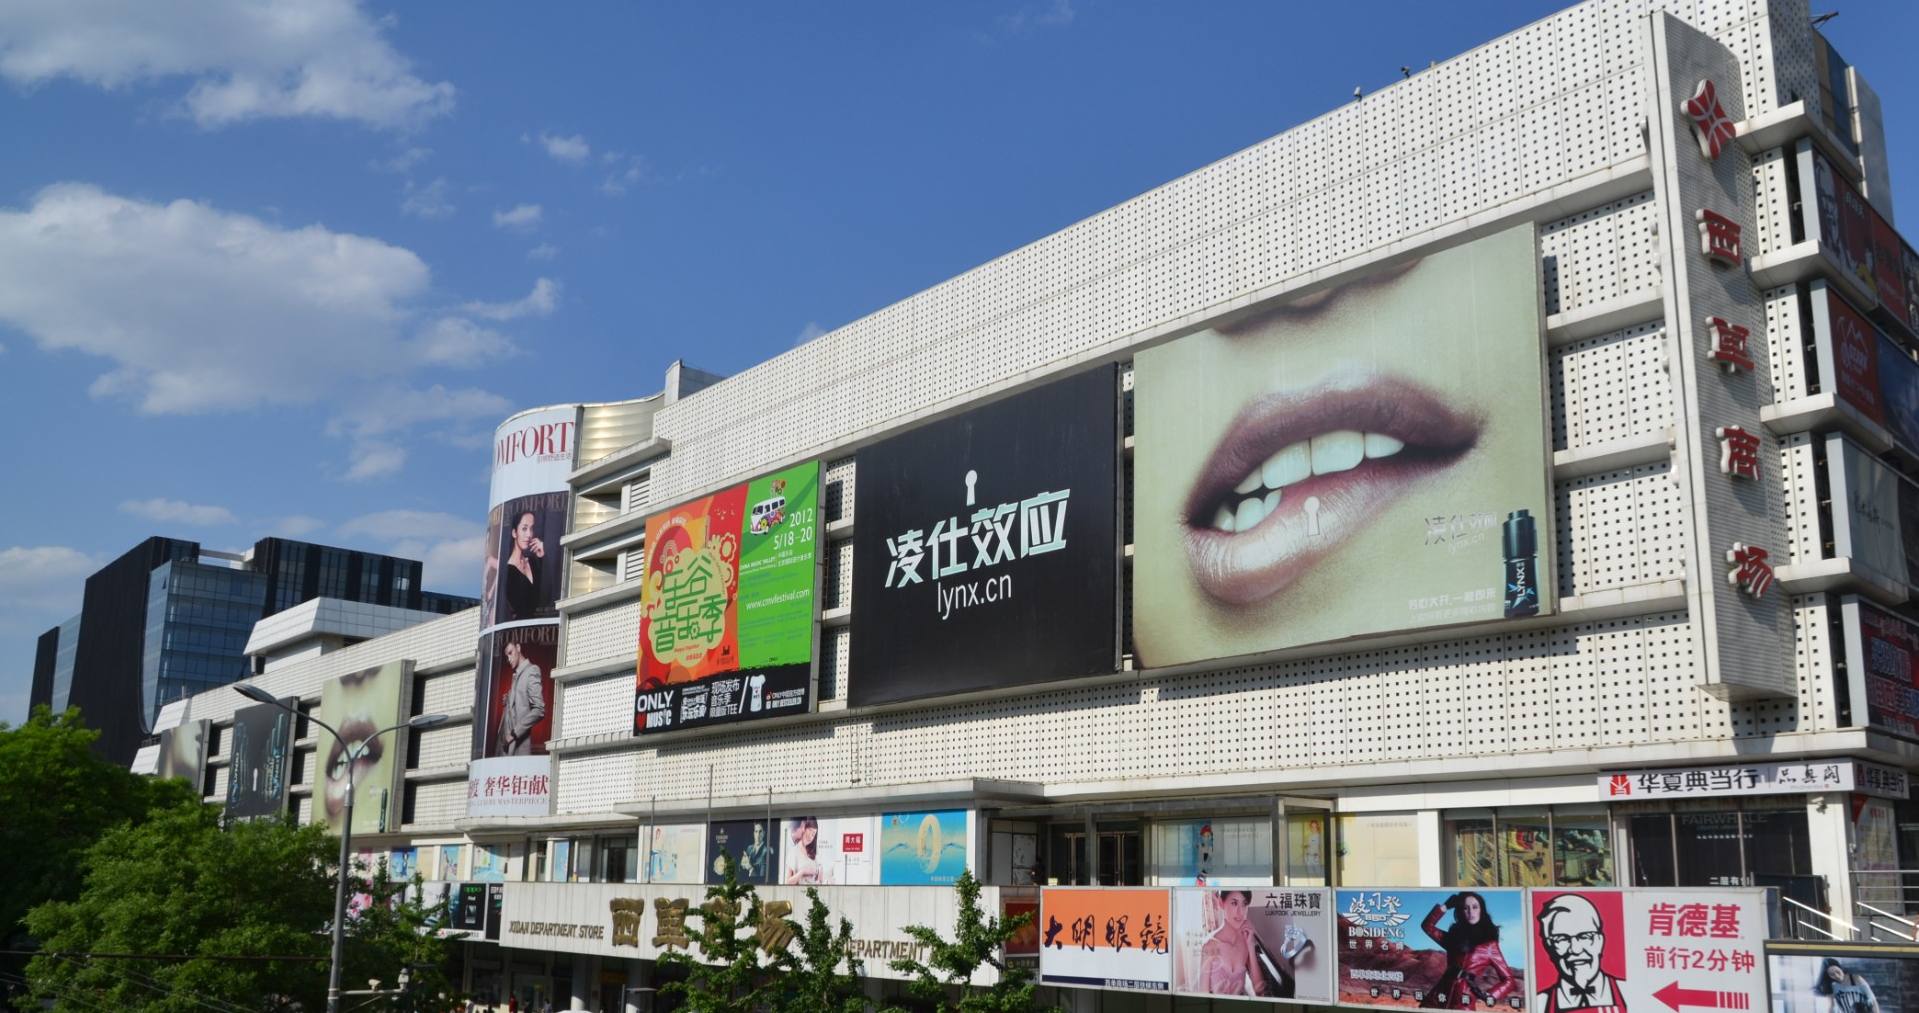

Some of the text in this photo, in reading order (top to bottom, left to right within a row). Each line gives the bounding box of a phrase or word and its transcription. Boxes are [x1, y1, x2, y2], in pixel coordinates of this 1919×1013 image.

[790, 507, 813, 528] 2012
[884, 488, 1071, 588] 凌仕效应
[1516, 567, 1525, 597] LYNX
[937, 573, 1012, 621] lynx.cn
[637, 690, 674, 713] ONLY
[485, 774, 549, 798] 奢华钜献
[1637, 768, 1759, 794] 华夏典当行
[1264, 892, 1322, 910] 六福珠寶
[508, 919, 604, 940] XIDAN DEPARTMENT STORE
[1348, 926, 1404, 938] BOSIDENG
[1648, 902, 1741, 939] 肯德基
[1644, 945, 1756, 974] 前行2分钟
